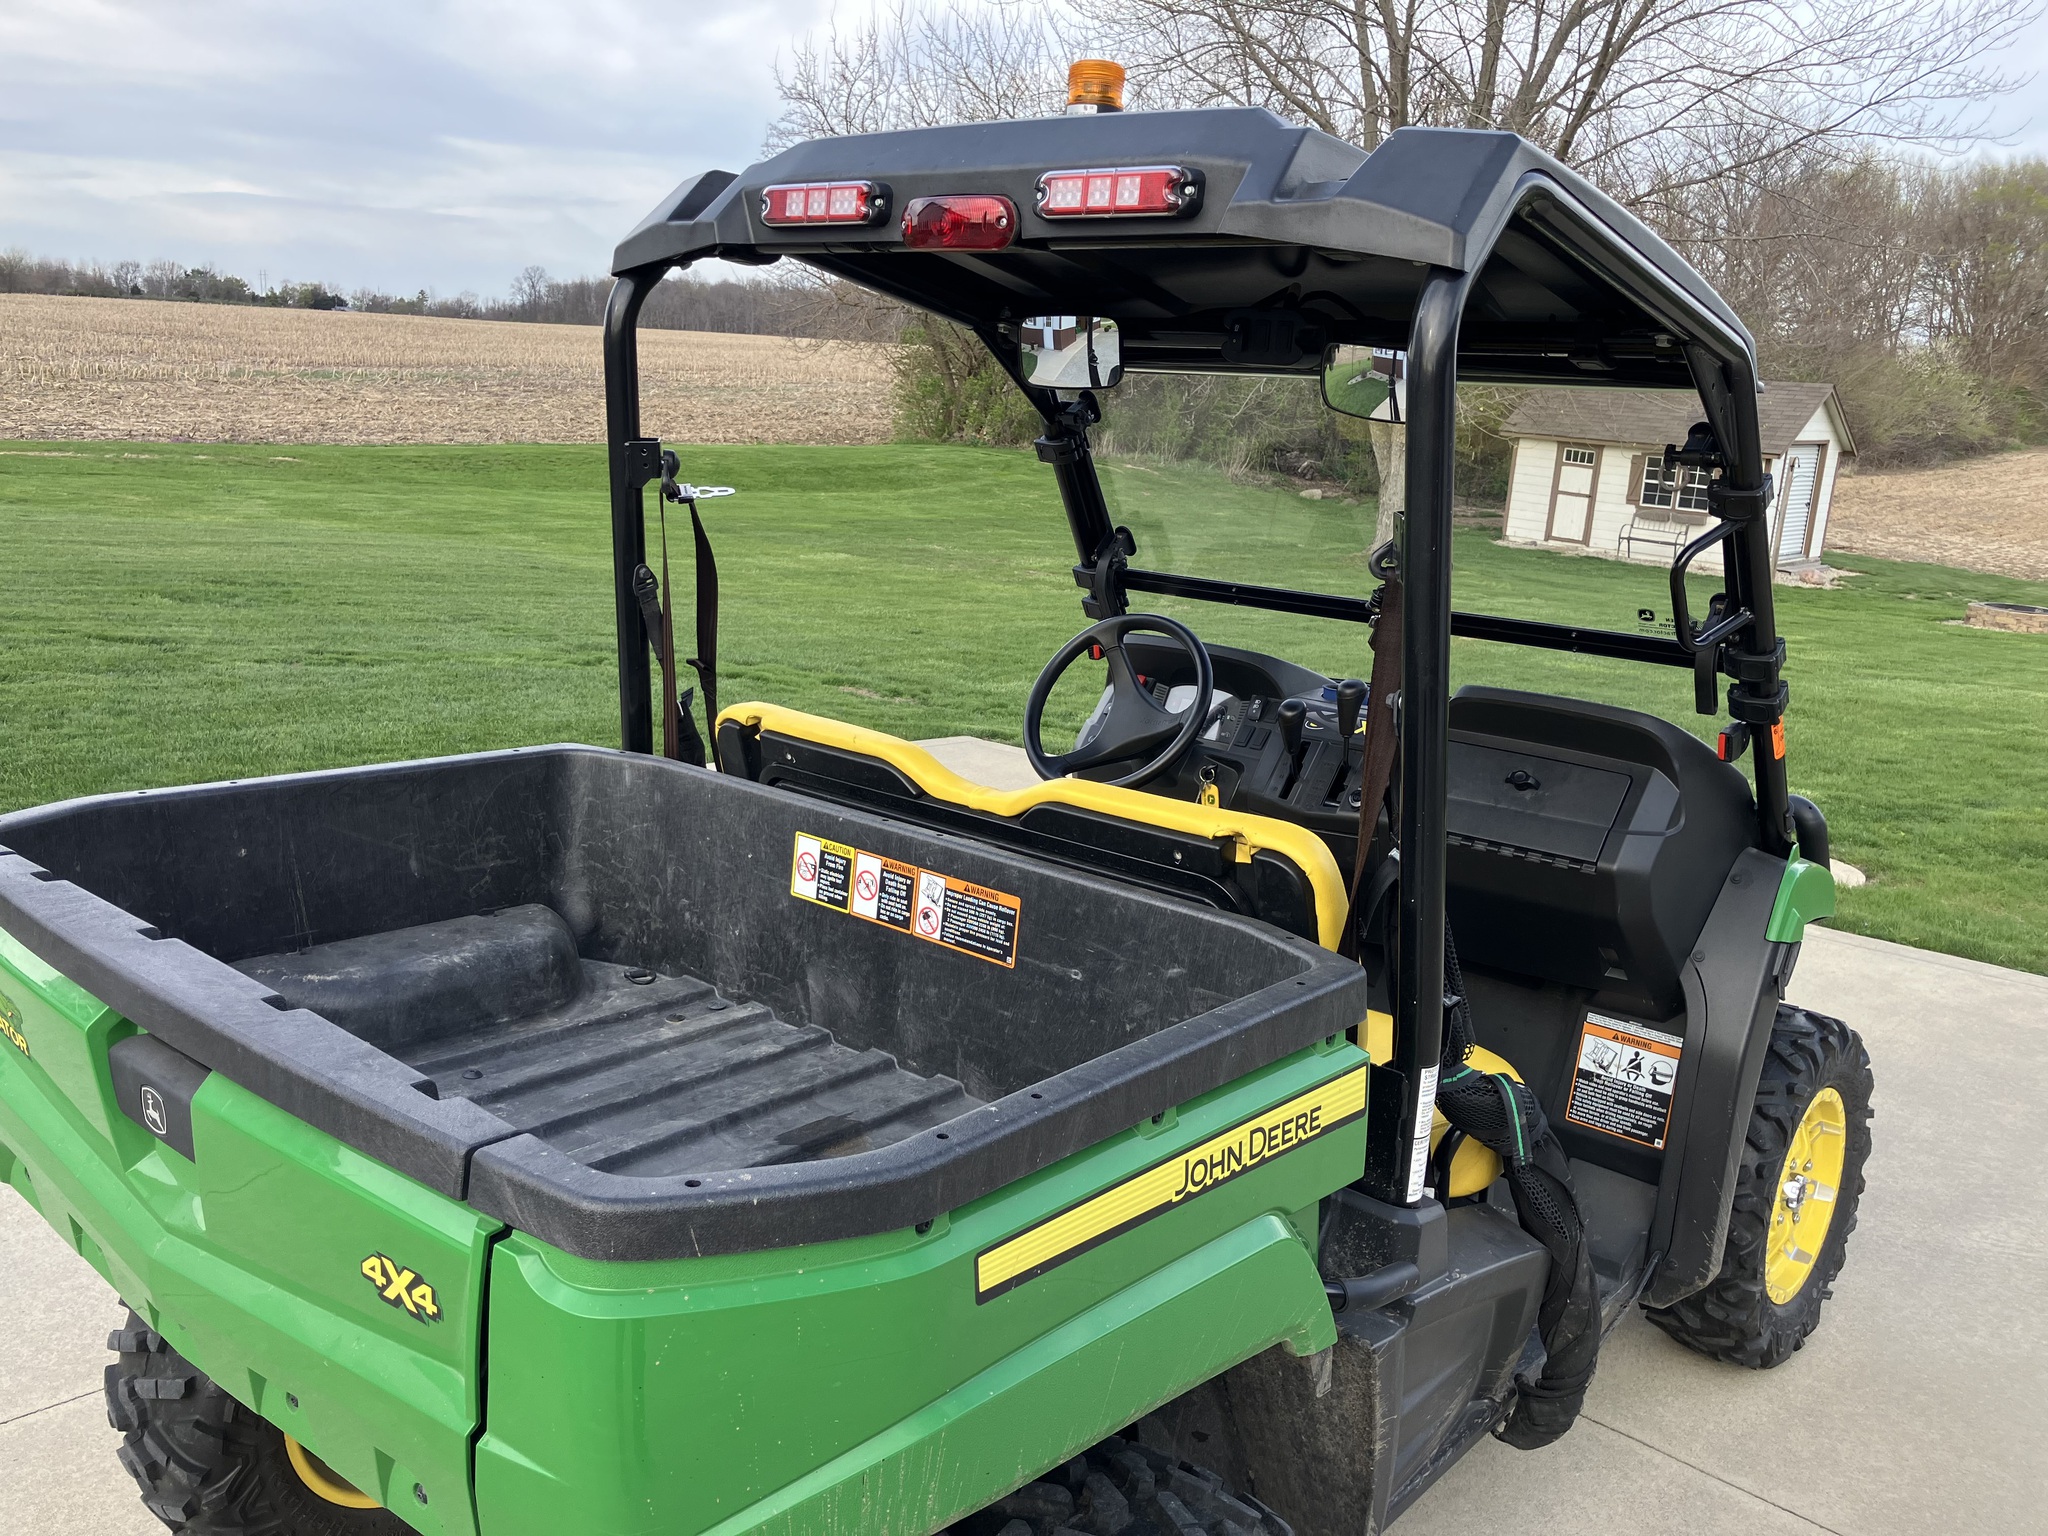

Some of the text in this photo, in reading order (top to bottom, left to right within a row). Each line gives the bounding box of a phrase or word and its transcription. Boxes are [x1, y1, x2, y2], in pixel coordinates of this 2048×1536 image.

[829, 844, 851, 856] CAUTION
[889, 862, 915, 875] WARNING
[970, 886, 999, 901] WARNING
[0, 1016, 29, 1056] ATOR
[1620, 1035, 1652, 1050] WARNING
[1614, 1079, 1626, 1087] Injury
[1175, 1105, 1322, 1197] JOHN DEERE
[361, 1254, 438, 1317] 4X4
